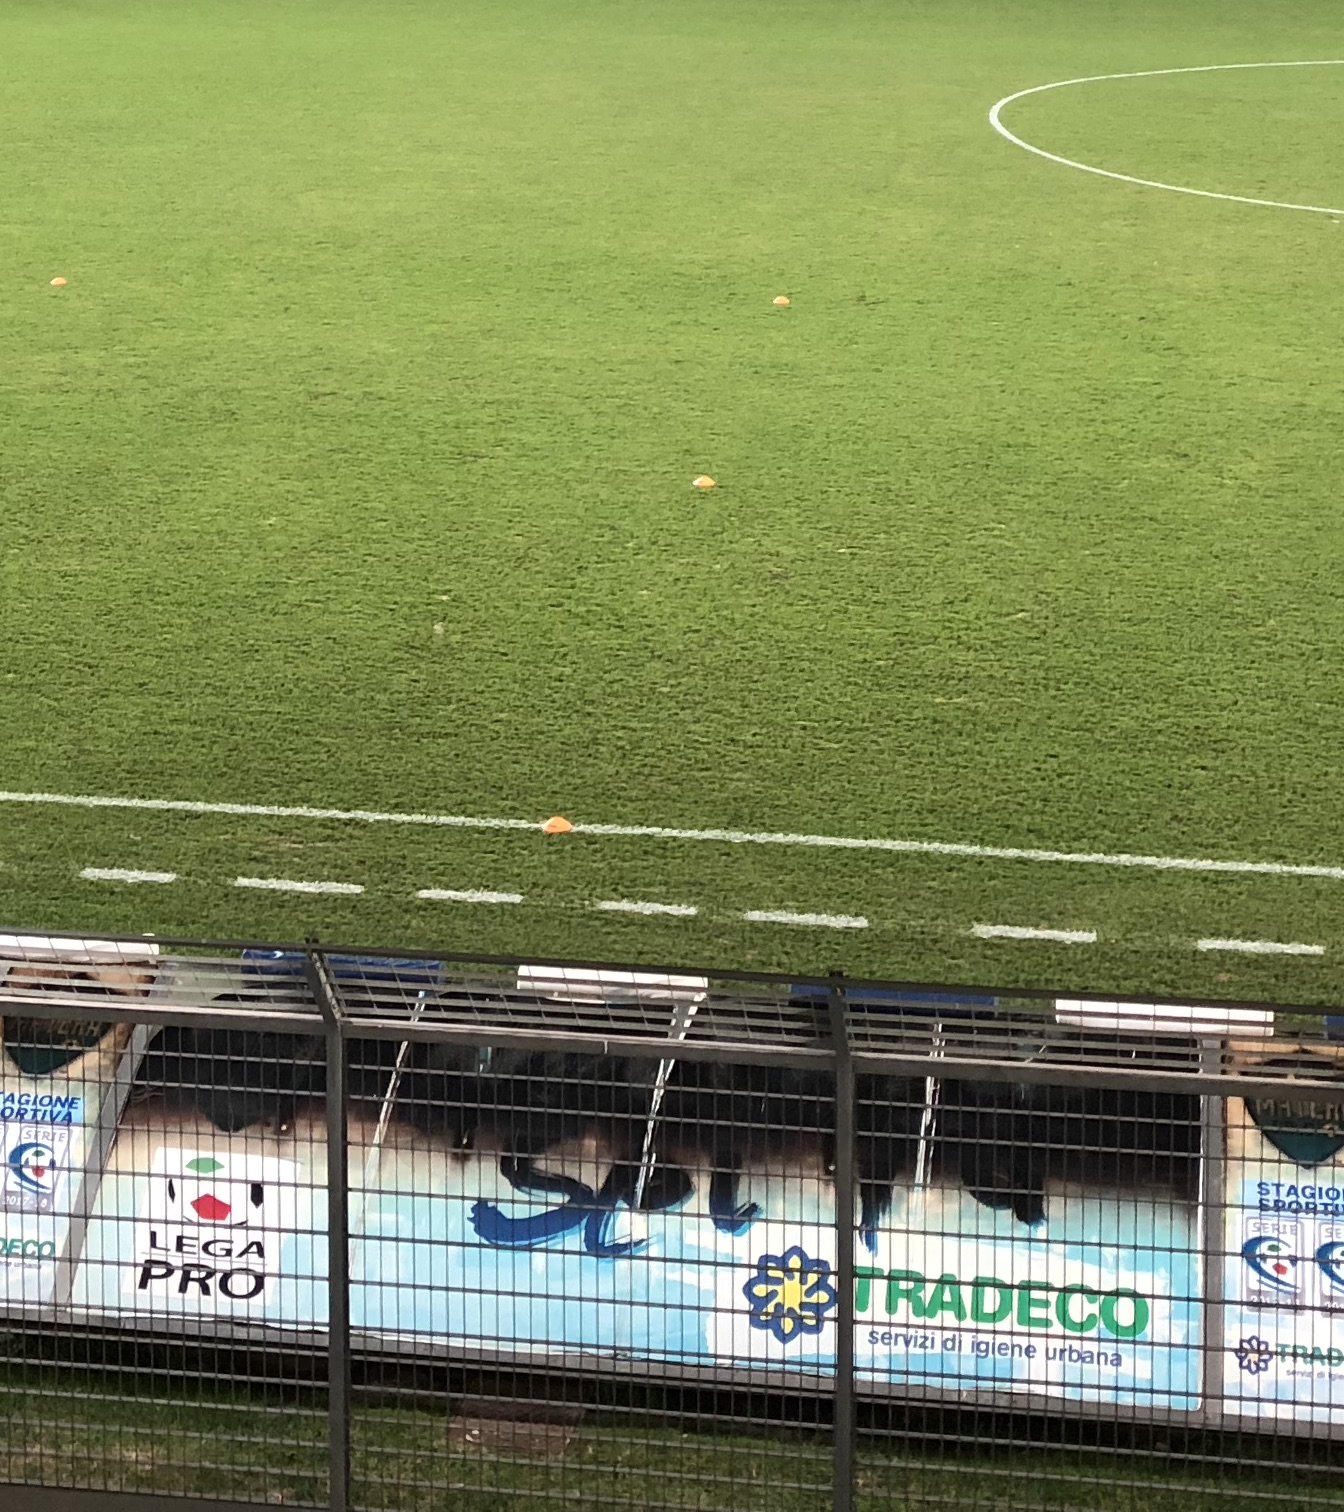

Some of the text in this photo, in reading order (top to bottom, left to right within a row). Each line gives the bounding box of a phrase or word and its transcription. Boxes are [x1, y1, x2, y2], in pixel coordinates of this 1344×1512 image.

[23, 1127, 68, 1143] SERIE
[150, 1231, 265, 1259] LEGA
[1252, 1221, 1298, 1236] SERIE
[138, 1259, 265, 1299] PRO
[853, 1265, 1149, 1337] TRADECO
[868, 1329, 1123, 1367] servizi di igiene urbana
